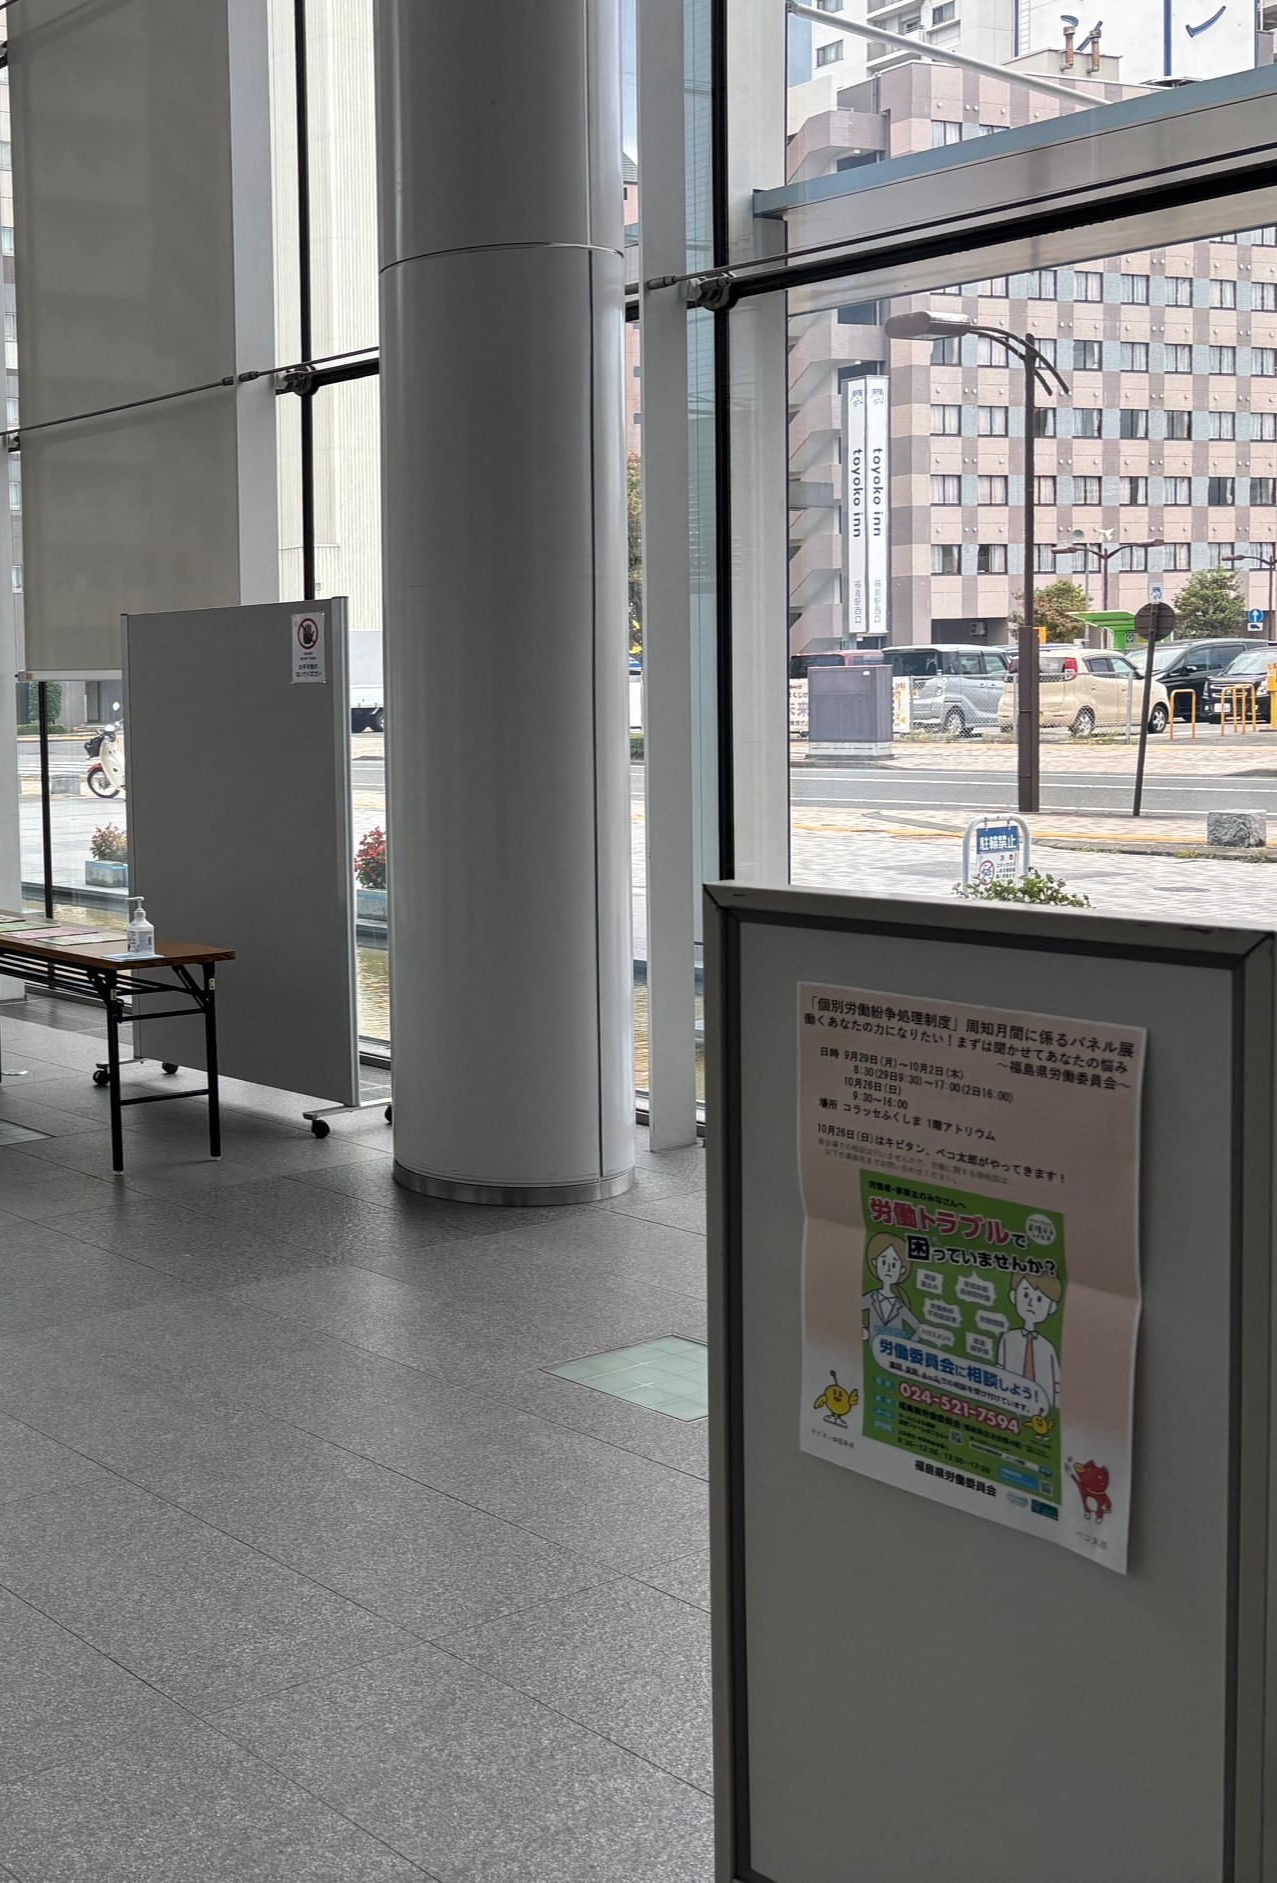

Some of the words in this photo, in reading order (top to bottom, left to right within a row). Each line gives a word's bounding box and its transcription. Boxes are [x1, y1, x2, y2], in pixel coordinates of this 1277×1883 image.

[851, 448, 863, 506] toyoko
[871, 447, 884, 505] toyoko
[853, 512, 863, 537] inn
[873, 511, 883, 536] inn
[979, 834, 1017, 850] 駐輪禁止
[819, 1046, 839, 1059] 日時
[843, 1075, 902, 1096] 10月26日(日)
[818, 1097, 838, 1111] 場所
[843, 1102, 922, 1127] コラッセふくしま
[927, 1118, 996, 1141] 1階アトリウム
[868, 1196, 1029, 1249] 労働トラブルで
[905, 1233, 1057, 1277] 困っていませんか?
[879, 1338, 1039, 1403] 労働委員会に相談しよう!
[898, 1382, 1021, 1435] 024-521-7594
[914, 1458, 997, 1498] 福島県労働委員会
